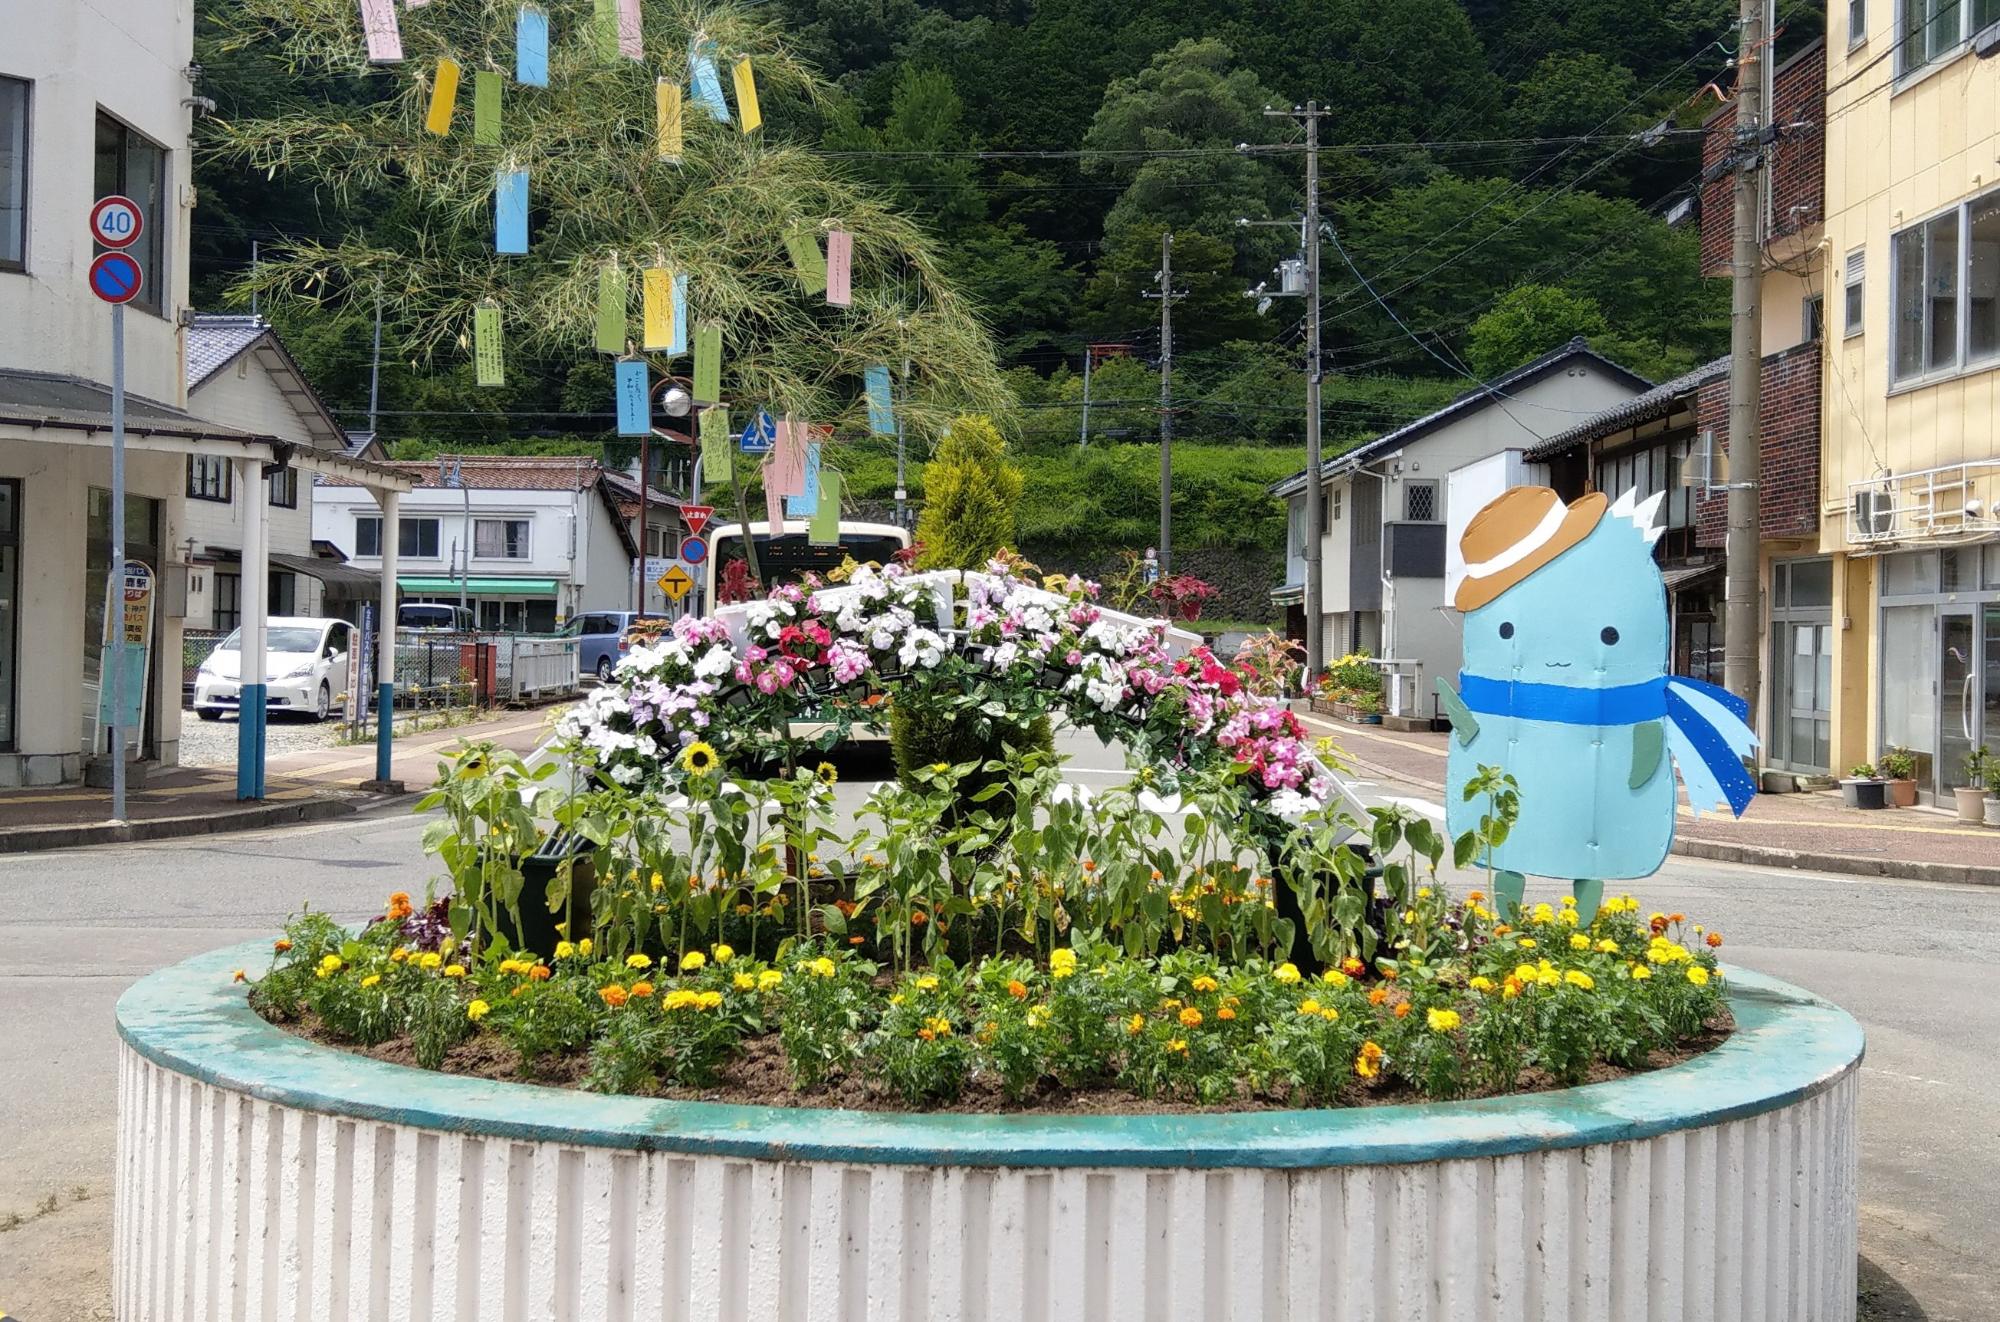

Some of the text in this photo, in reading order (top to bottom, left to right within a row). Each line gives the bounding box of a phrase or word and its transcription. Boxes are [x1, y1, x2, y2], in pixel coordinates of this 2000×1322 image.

[102, 211, 131, 234] 40
[687, 511, 707, 519] 止まれ
[125, 577, 147, 588] 鹿駅
